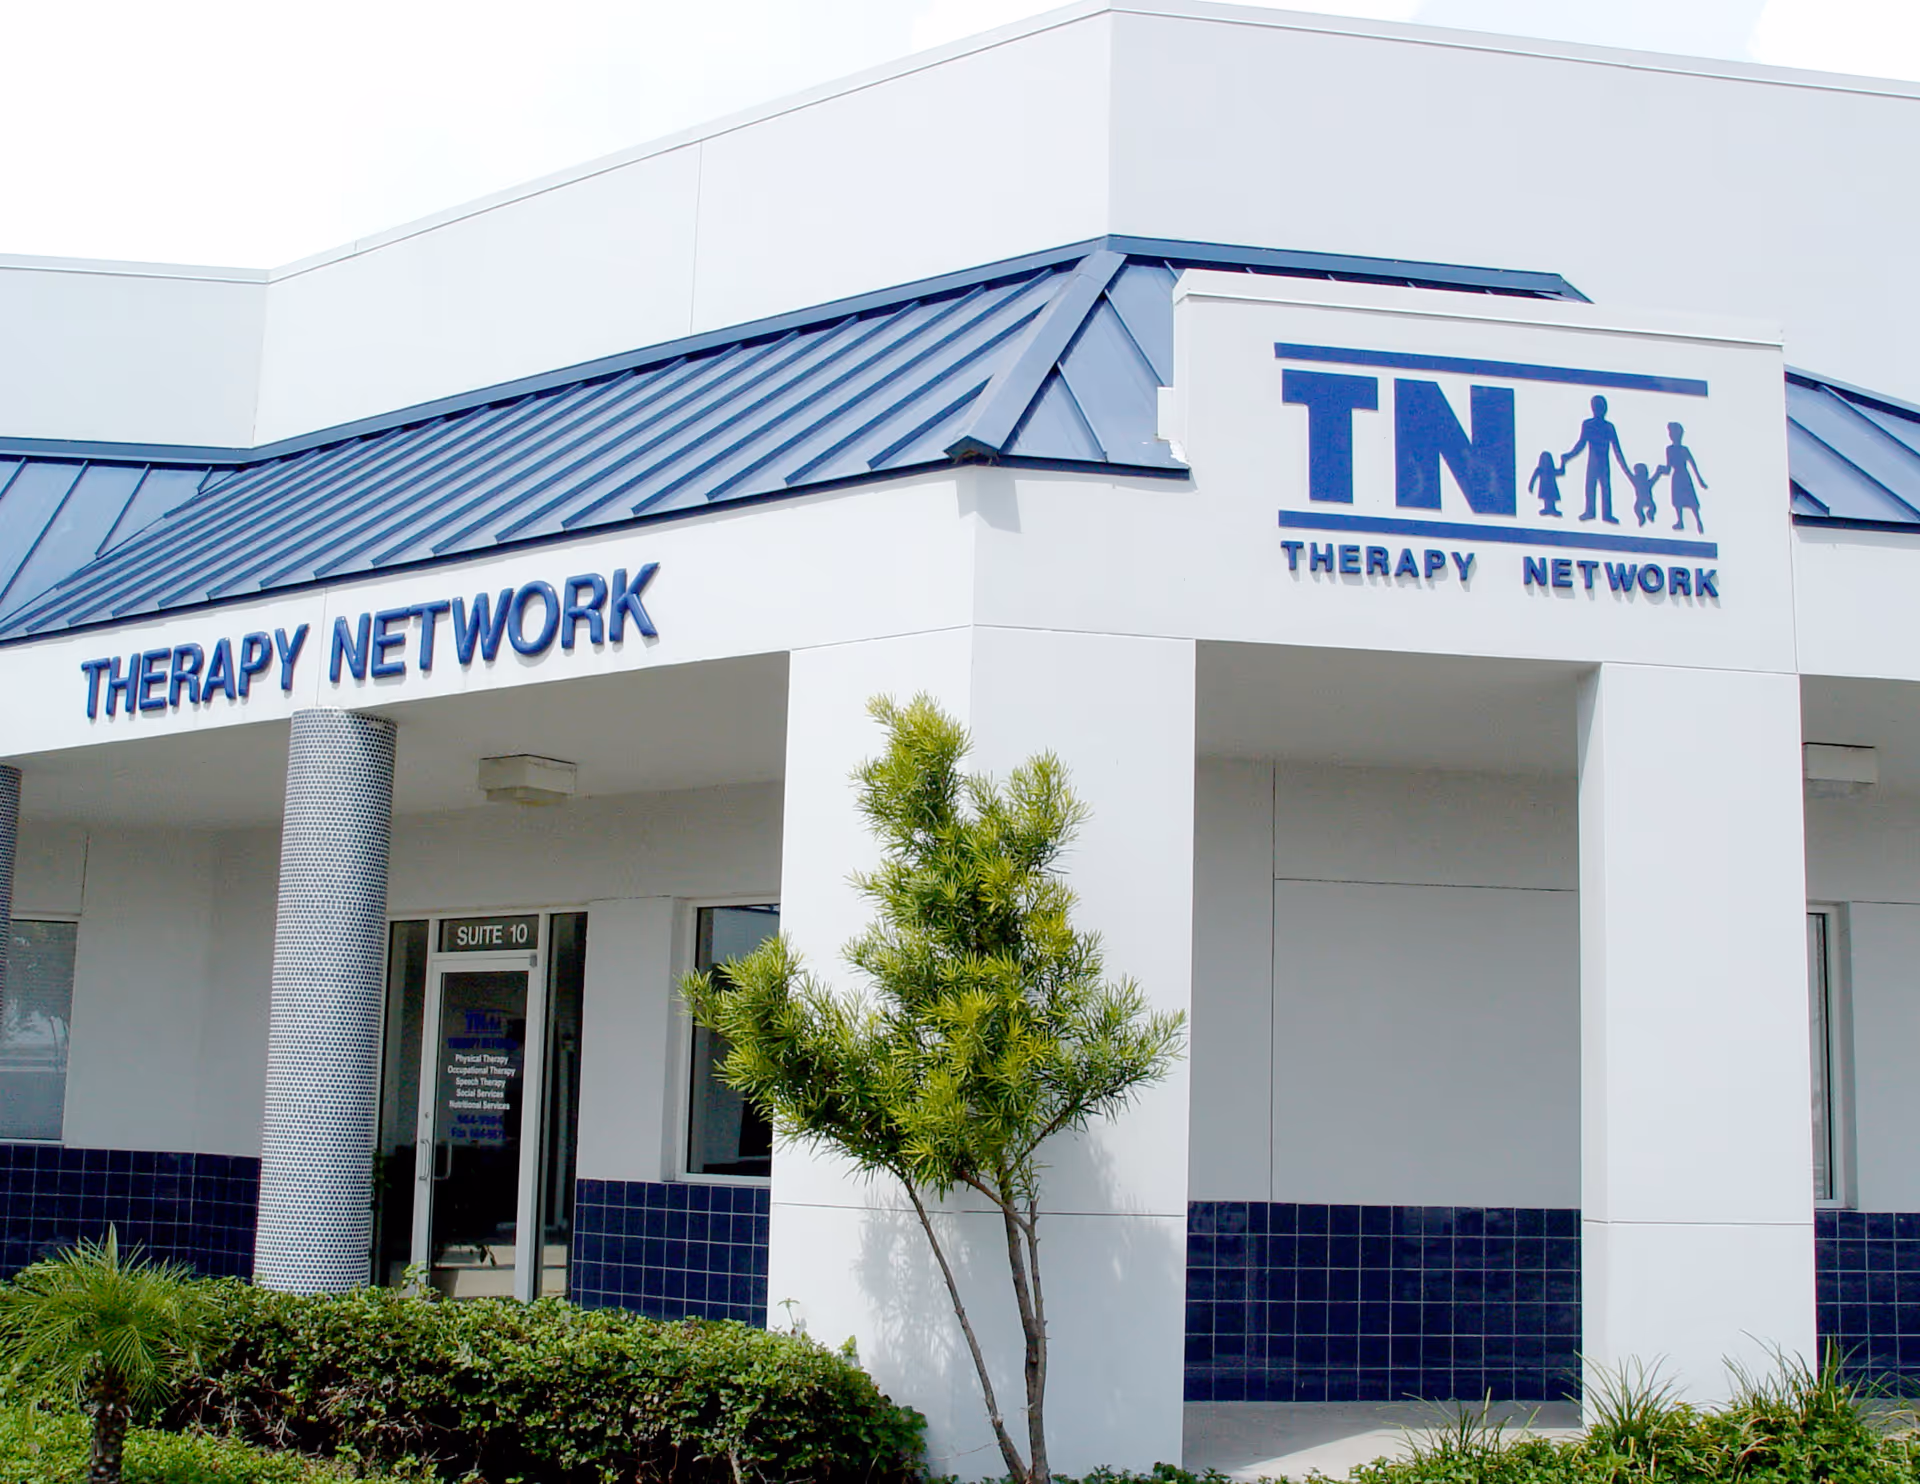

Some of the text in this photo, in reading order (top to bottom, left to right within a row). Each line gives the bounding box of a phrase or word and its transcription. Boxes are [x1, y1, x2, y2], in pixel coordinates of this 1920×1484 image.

[1281, 369, 1517, 517] TN
[1280, 540, 1720, 599] THERAPY NETWORK
[81, 562, 660, 720] THERAPY NETWORK
[457, 923, 528, 945] SUITE 10
[455, 1053, 509, 1065] Physical Therapy
[447, 1065, 516, 1077] Occupational Therapy
[455, 1077, 506, 1088] Speech Therapy
[456, 1088, 504, 1098] Social Services
[449, 1100, 511, 1110] Nutritional Services
